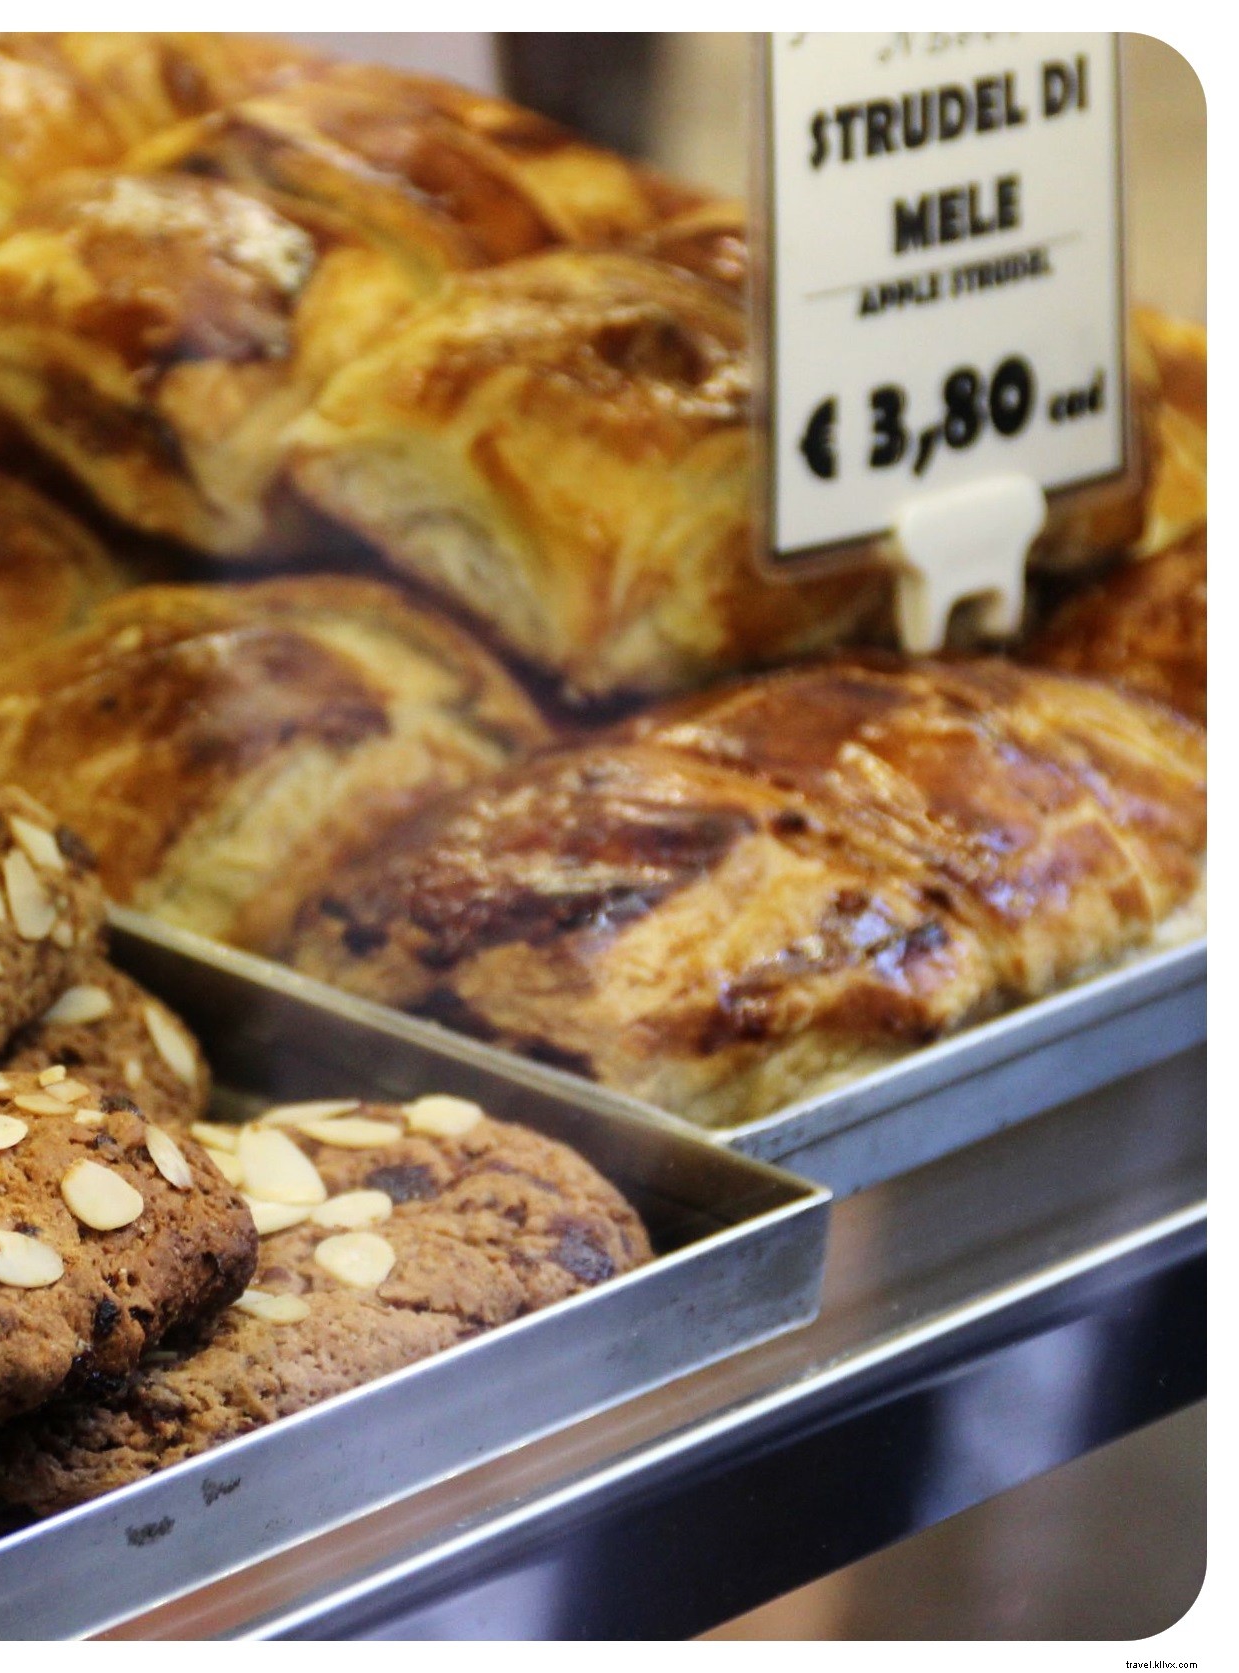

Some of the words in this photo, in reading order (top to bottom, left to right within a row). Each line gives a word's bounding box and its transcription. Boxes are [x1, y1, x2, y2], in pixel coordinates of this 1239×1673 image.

[808, 71, 1028, 171] STRUDEL
[1040, 53, 1089, 119] DI
[893, 173, 1021, 257] MELE
[868, 351, 1038, 478] 3,80
